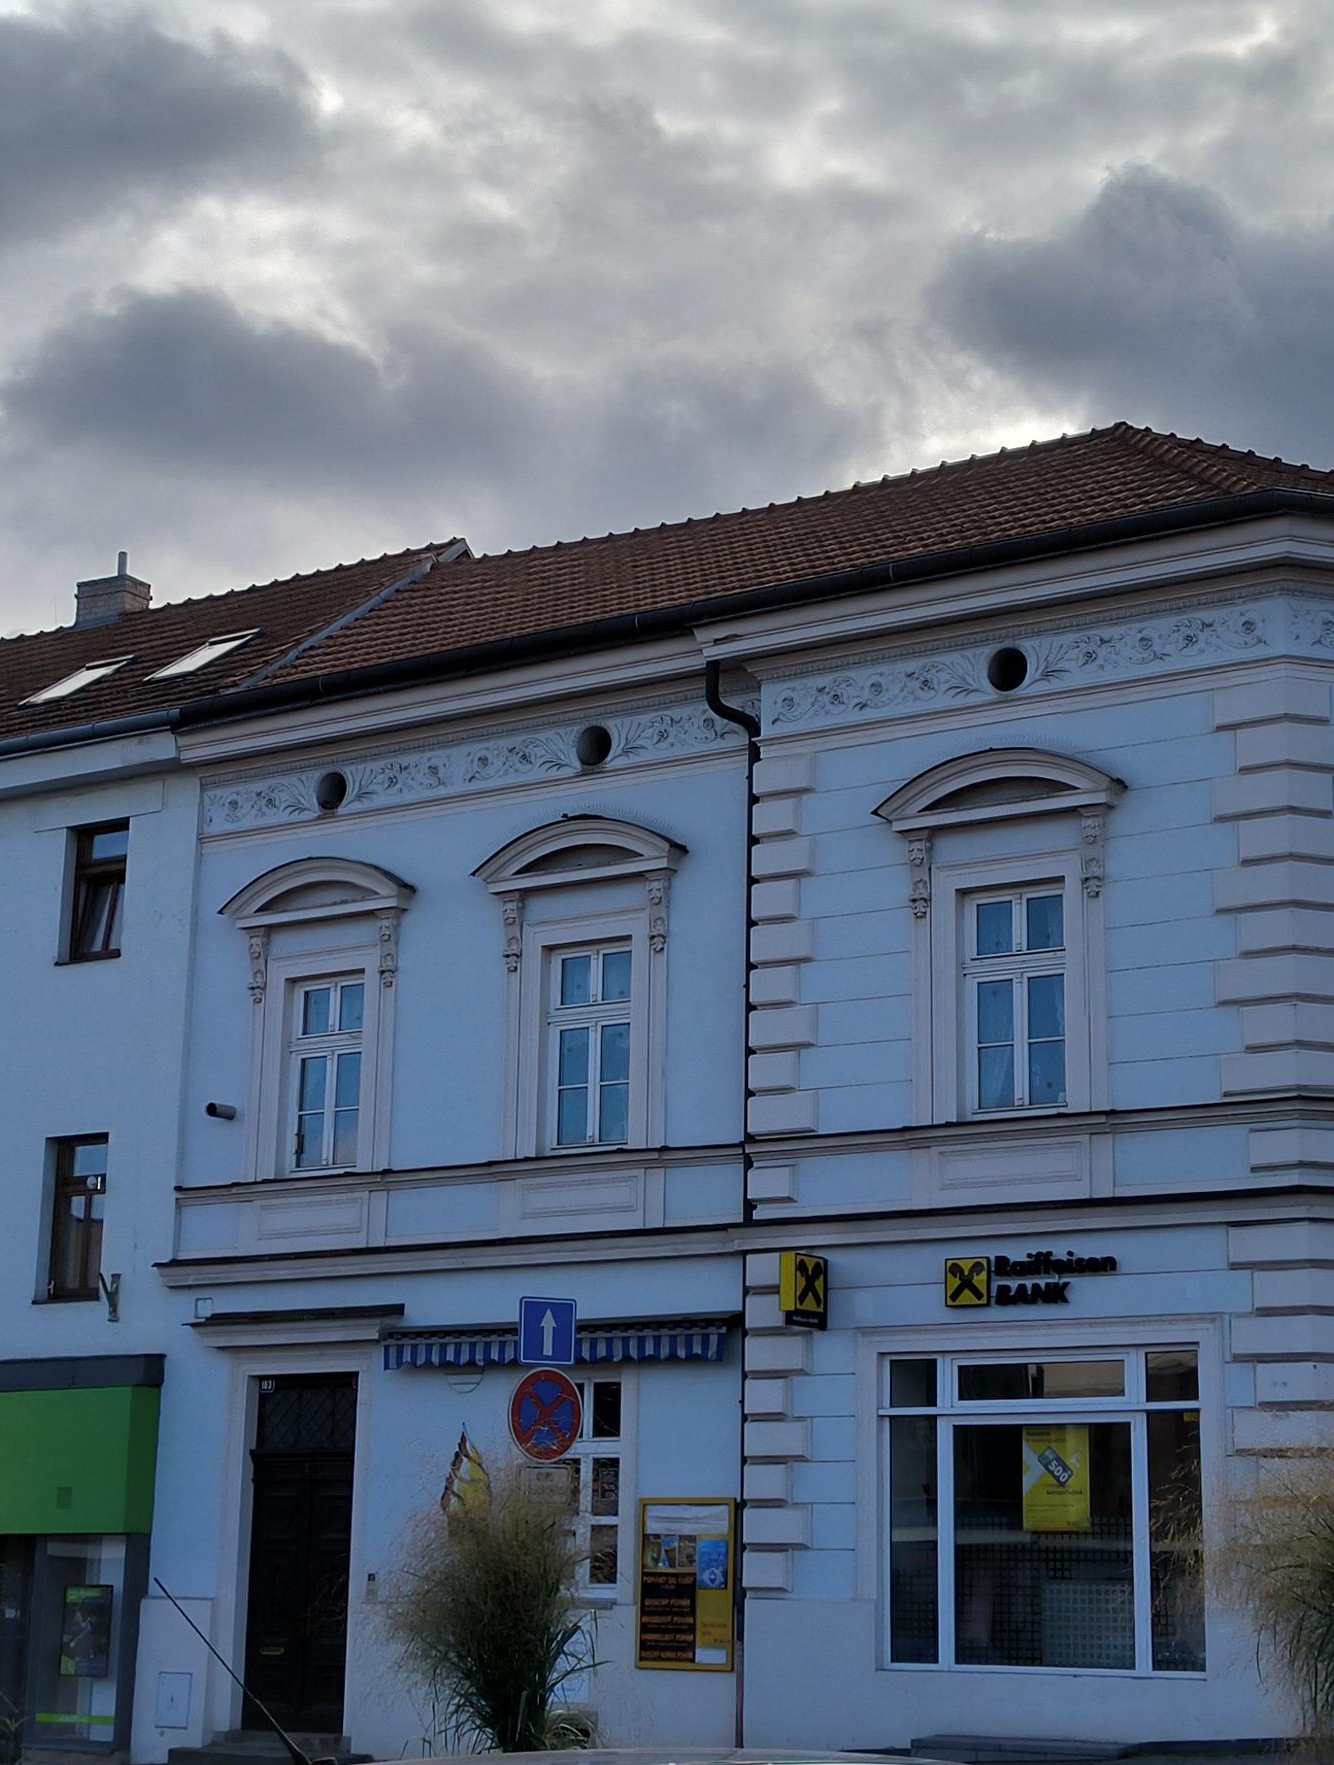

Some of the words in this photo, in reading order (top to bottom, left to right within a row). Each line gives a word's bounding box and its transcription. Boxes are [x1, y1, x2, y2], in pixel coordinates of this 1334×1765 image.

[994, 1250, 1117, 1277] Raiffeisen
[994, 1281, 1071, 1306] BANK
[1048, 1460, 1069, 1483] 500
